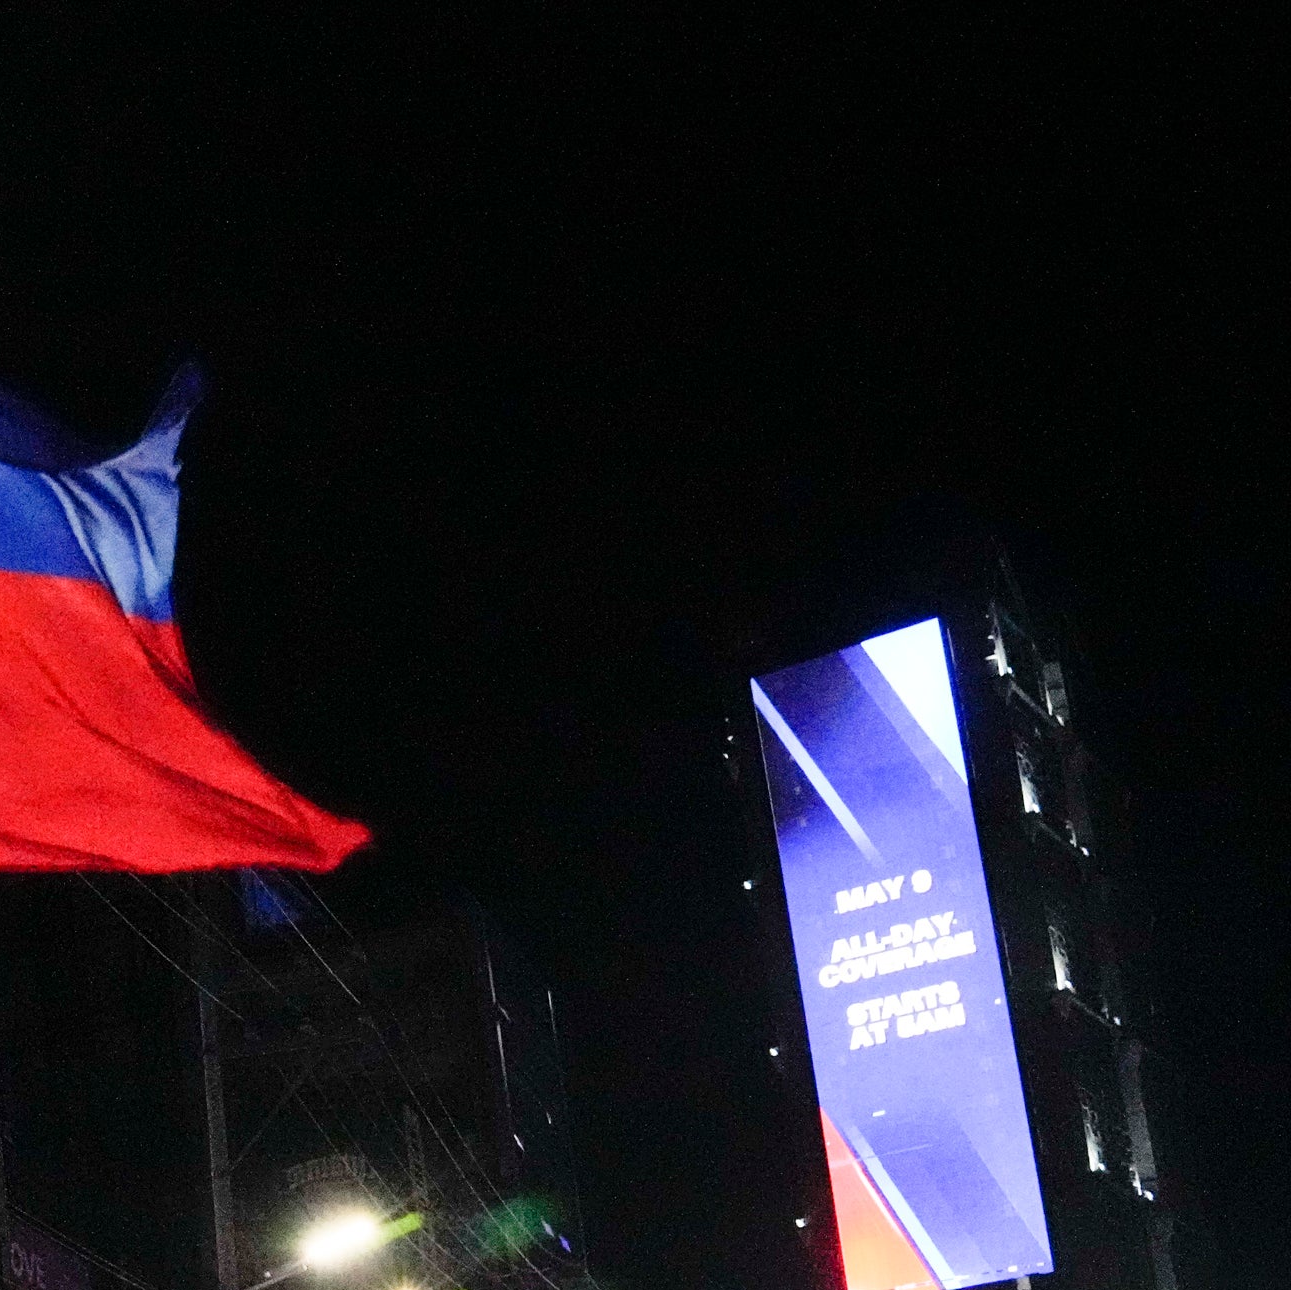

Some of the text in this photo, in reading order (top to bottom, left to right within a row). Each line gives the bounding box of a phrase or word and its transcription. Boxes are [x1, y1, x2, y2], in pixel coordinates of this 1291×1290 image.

[835, 869, 933, 914] MAY 9
[818, 930, 977, 988] COVERAGE
[830, 911, 955, 963] ALL-DAY
[846, 980, 961, 1027] STARTS
[849, 1020, 890, 1051] AT
